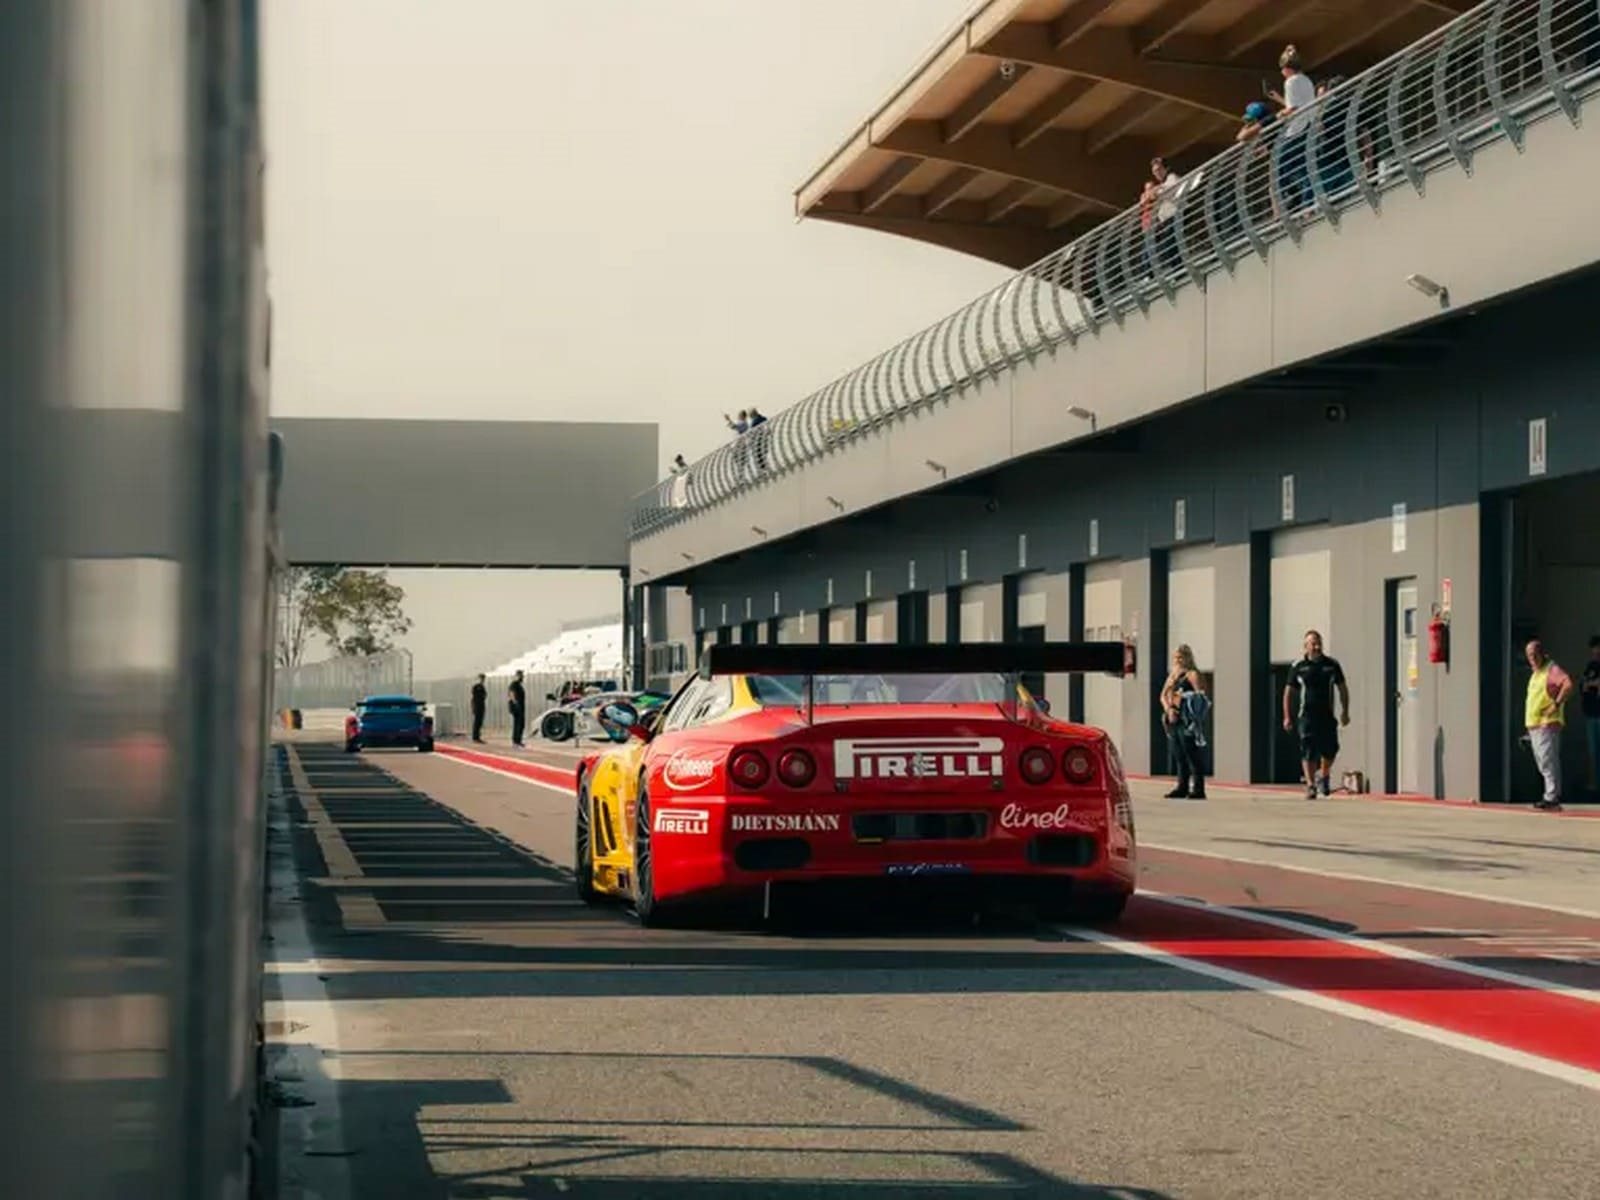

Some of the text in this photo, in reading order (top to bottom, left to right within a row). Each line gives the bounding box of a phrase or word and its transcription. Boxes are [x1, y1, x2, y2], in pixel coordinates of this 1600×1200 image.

[834, 737, 1004, 778] PIRELLI
[654, 808, 709, 834] PIRELLI
[731, 814, 840, 831] DIETSMANN
